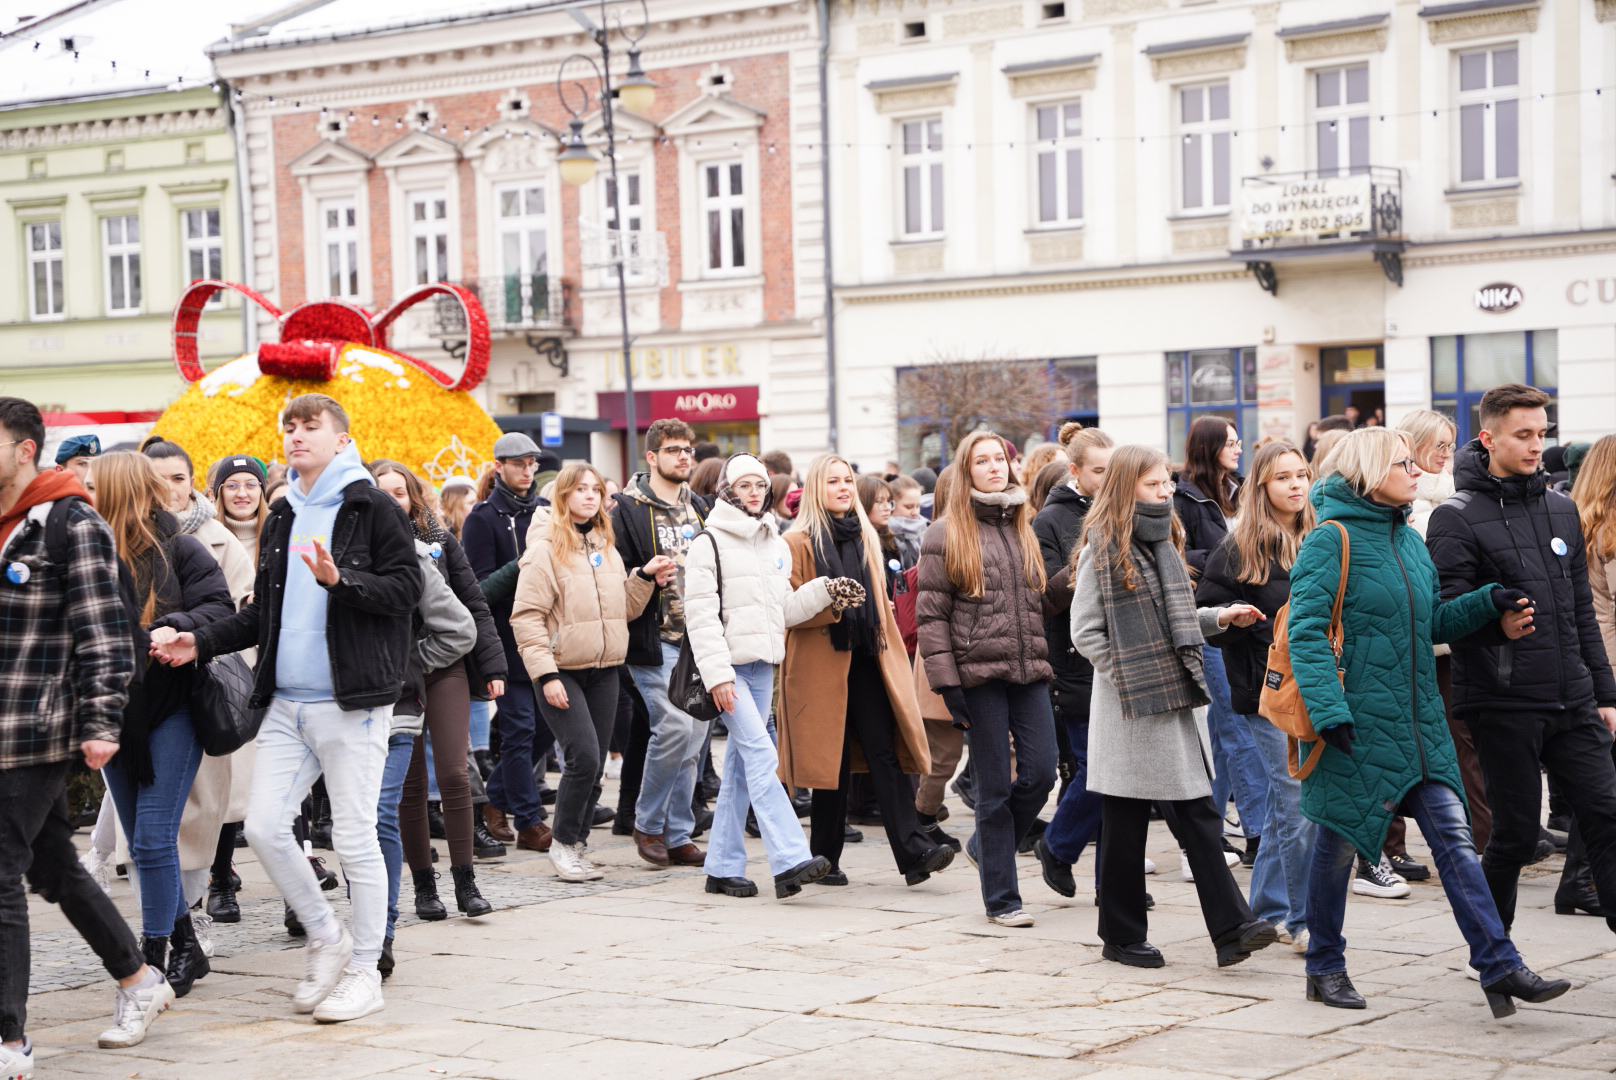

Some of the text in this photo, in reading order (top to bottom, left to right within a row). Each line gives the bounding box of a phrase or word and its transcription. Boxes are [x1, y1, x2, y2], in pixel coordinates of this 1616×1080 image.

[1282, 181, 1327, 197] LOKAL
[1251, 195, 1360, 215] DO WYNAJĘCIA
[1474, 287, 1523, 308] NIKA
[604, 344, 743, 388] JUBILER
[675, 392, 737, 413] ADORO
